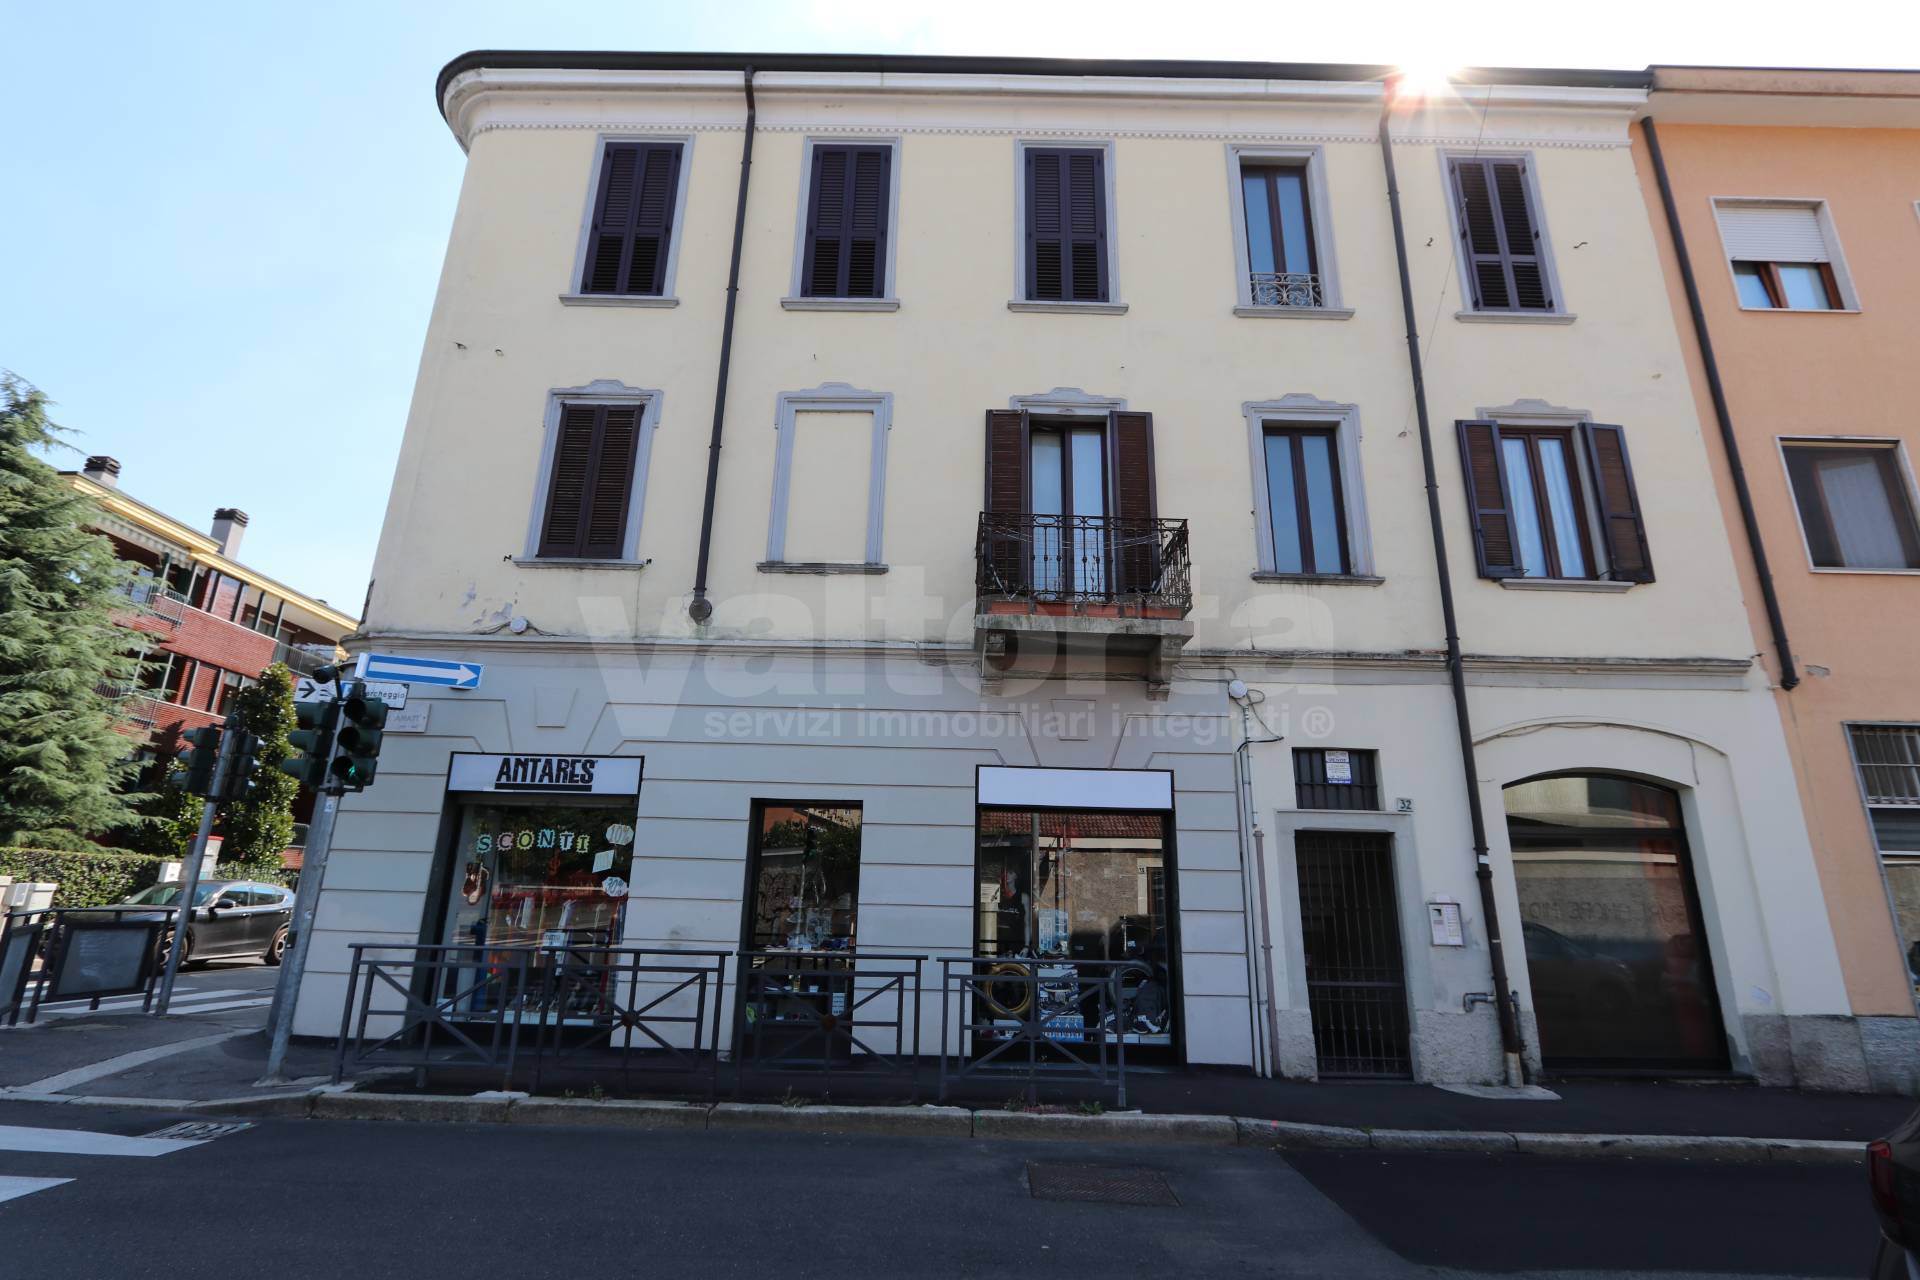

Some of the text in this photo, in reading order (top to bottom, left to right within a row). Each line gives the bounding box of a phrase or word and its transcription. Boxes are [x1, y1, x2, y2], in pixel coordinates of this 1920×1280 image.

[365, 690, 405, 701] archeggio
[496, 757, 595, 784] ANTARES
[1400, 799, 1412, 810] 32
[478, 831, 588, 852] SCONTI
